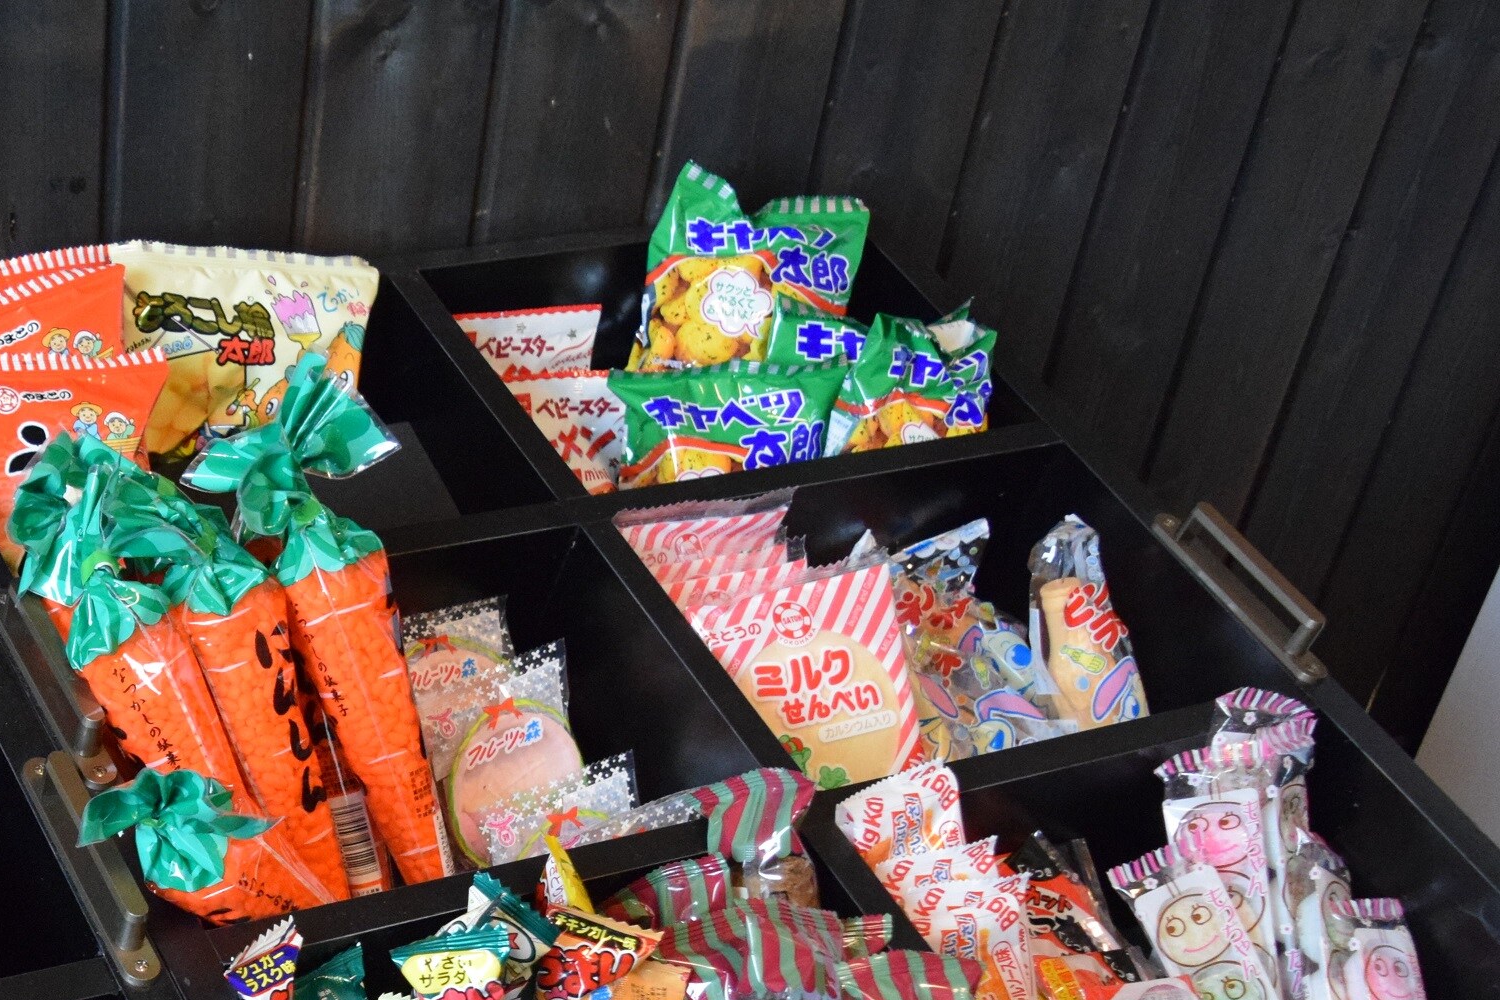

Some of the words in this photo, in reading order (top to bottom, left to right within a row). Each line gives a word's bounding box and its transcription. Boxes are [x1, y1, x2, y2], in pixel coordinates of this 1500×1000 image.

[770, 245, 849, 294] 太郎
[216, 335, 276, 366] 太郎
[479, 334, 555, 359] ベビースター
[536, 396, 620, 420] ベビースター
[641, 389, 805, 432] キャベツ
[739, 420, 825, 471] 太郎
[584, 468, 610, 482] mini
[705, 622, 762, 647] さとうの
[753, 648, 851, 698] ミルク
[111, 667, 182, 771] なつかしの駄菓
[781, 683, 881, 725] せんべい
[466, 719, 543, 770] フルーツの森
[824, 712, 892, 739] カルシウム入り
[930, 773, 960, 812] Big
[1246, 800, 1268, 899] もっちゃん
[554, 913, 638, 951] チキンカレー味
[985, 896, 1020, 932] Big
[1206, 887, 1261, 982] もっちゃん
[235, 950, 285, 980] シュガー
[246, 960, 297, 993] ラスク味
[419, 970, 483, 988] サラダ
